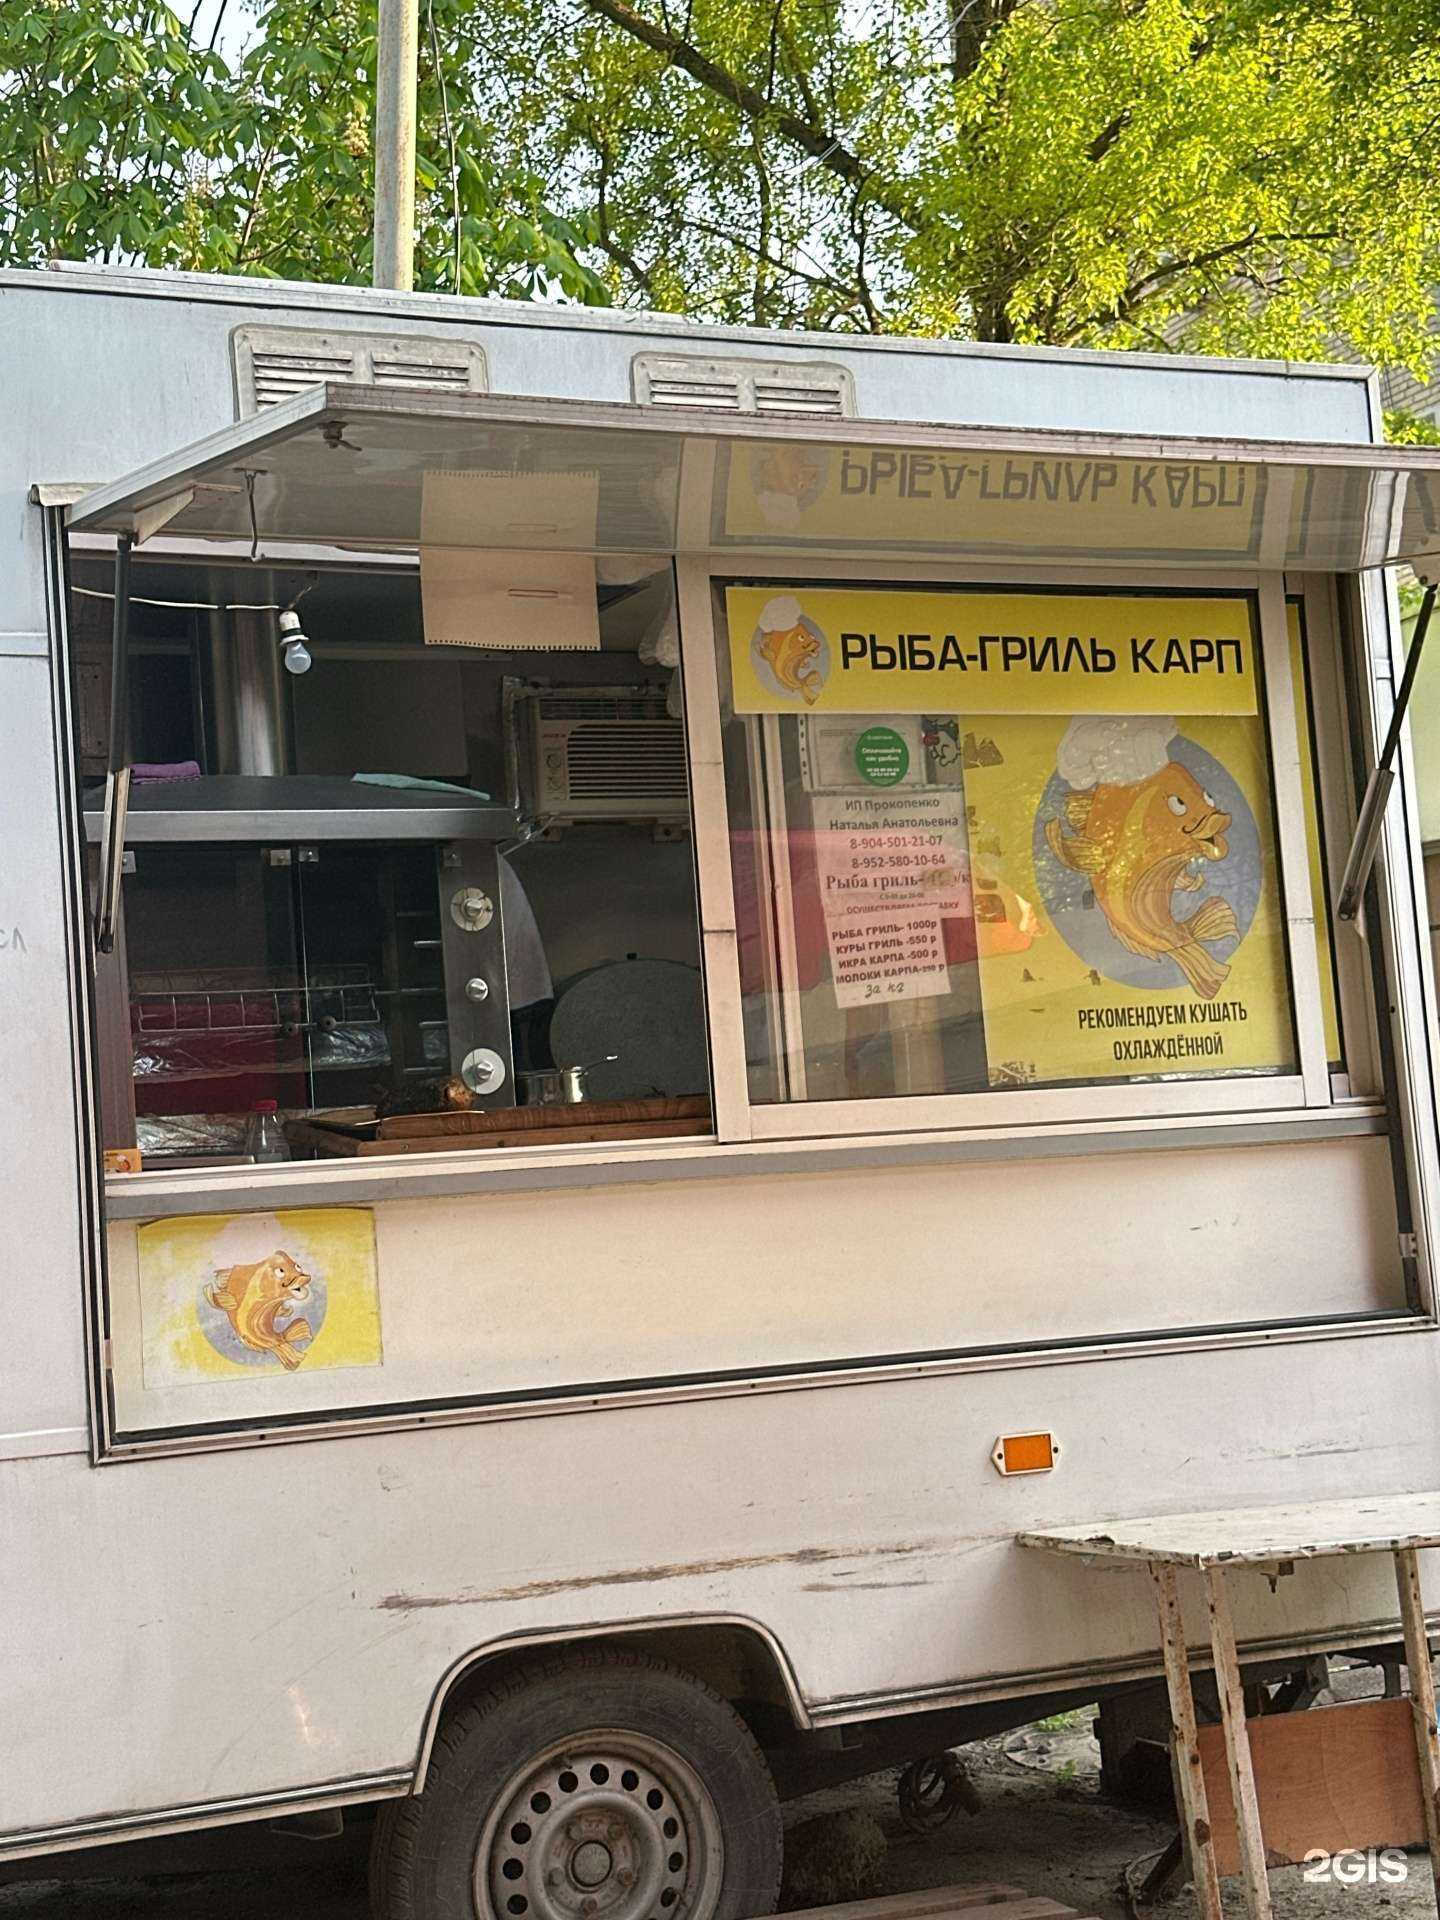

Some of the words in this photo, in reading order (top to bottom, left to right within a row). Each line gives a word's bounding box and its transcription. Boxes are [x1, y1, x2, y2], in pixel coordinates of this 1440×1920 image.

[841, 632, 1117, 675] РЫБА-ГРИЛЬ
[1129, 637, 1244, 675] КАРП
[845, 799, 862, 811] ИП
[865, 797, 940, 813] Прокопенко
[829, 819, 879, 831] Наталья
[882, 816, 959, 829] Анатольевна
[850, 835, 943, 850] 8-904-501-21-07
[851, 854, 946, 869] 8-952-580-10-64
[825, 872, 868, 890] Рыба
[832, 928, 863, 941] РЫБА
[907, 919, 937, 930] 1000р
[836, 942, 866, 955] КУРЫ
[868, 938, 903, 950] ГРИЛЬ
[931, 935, 937, 944] р
[838, 957, 867, 969] ИКРА
[869, 952, 905, 965] КАРПА
[932, 950, 938, 959] р
[836, 971, 881, 985] МОЛОКИ
[1078, 1004, 1187, 1029] РЕКОМЕНДУЕМ
[1189, 1001, 1248, 1024] КУШАТЬ
[1113, 1032, 1224, 1061] ОХЛАЖДЁННОЙ
